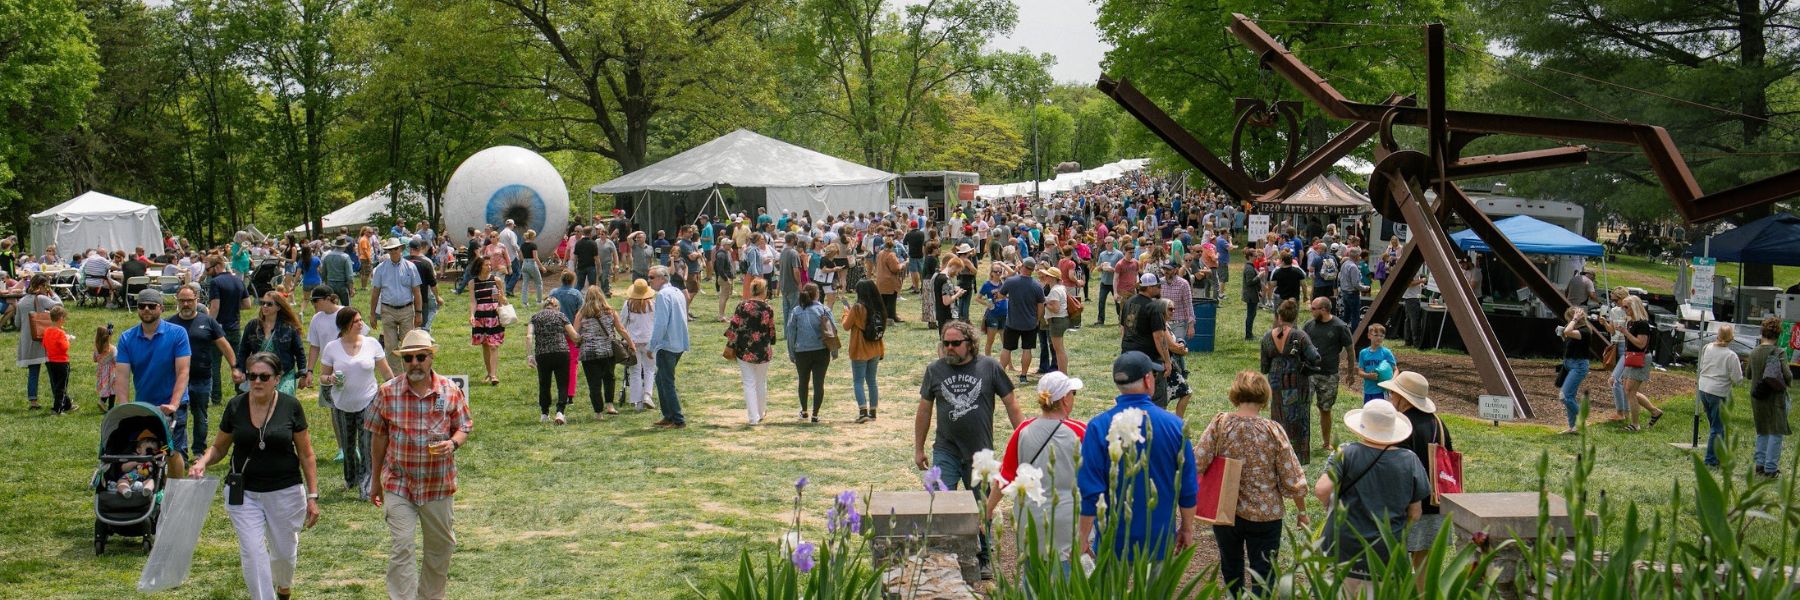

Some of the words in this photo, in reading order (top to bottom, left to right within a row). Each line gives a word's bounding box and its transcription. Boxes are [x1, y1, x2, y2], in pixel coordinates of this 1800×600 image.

[1261, 203, 1280, 212] 1220
[943, 375, 956, 386] TOP
[958, 374, 977, 385] PICKS
